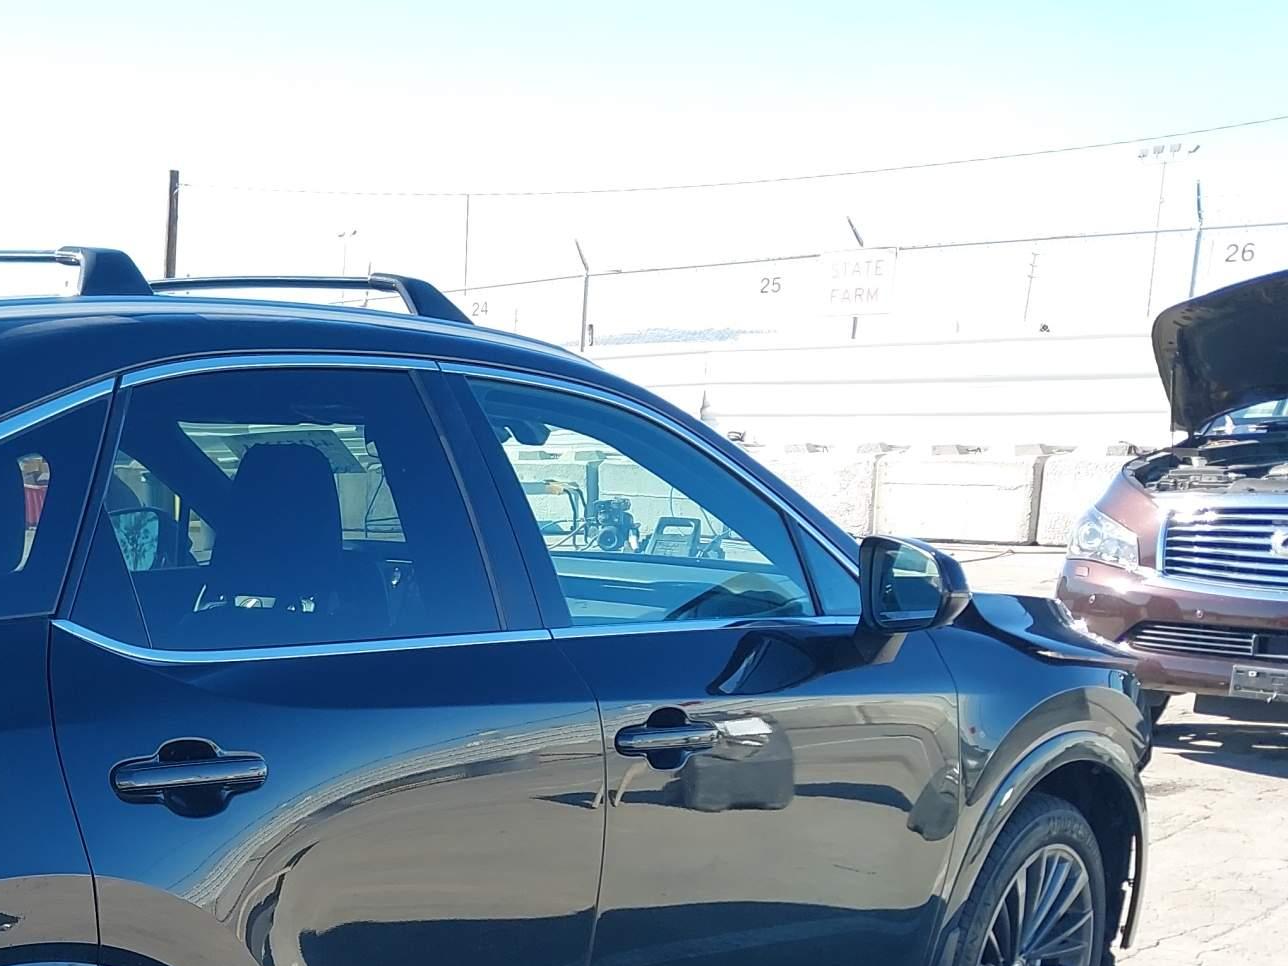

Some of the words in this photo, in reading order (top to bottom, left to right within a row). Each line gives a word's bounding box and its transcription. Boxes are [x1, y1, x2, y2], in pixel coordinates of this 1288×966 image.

[1225, 242, 1255, 262] 26
[832, 260, 884, 279] STATE
[760, 277, 782, 294] 25
[830, 287, 881, 305] FARM
[471, 301, 489, 317] 24
